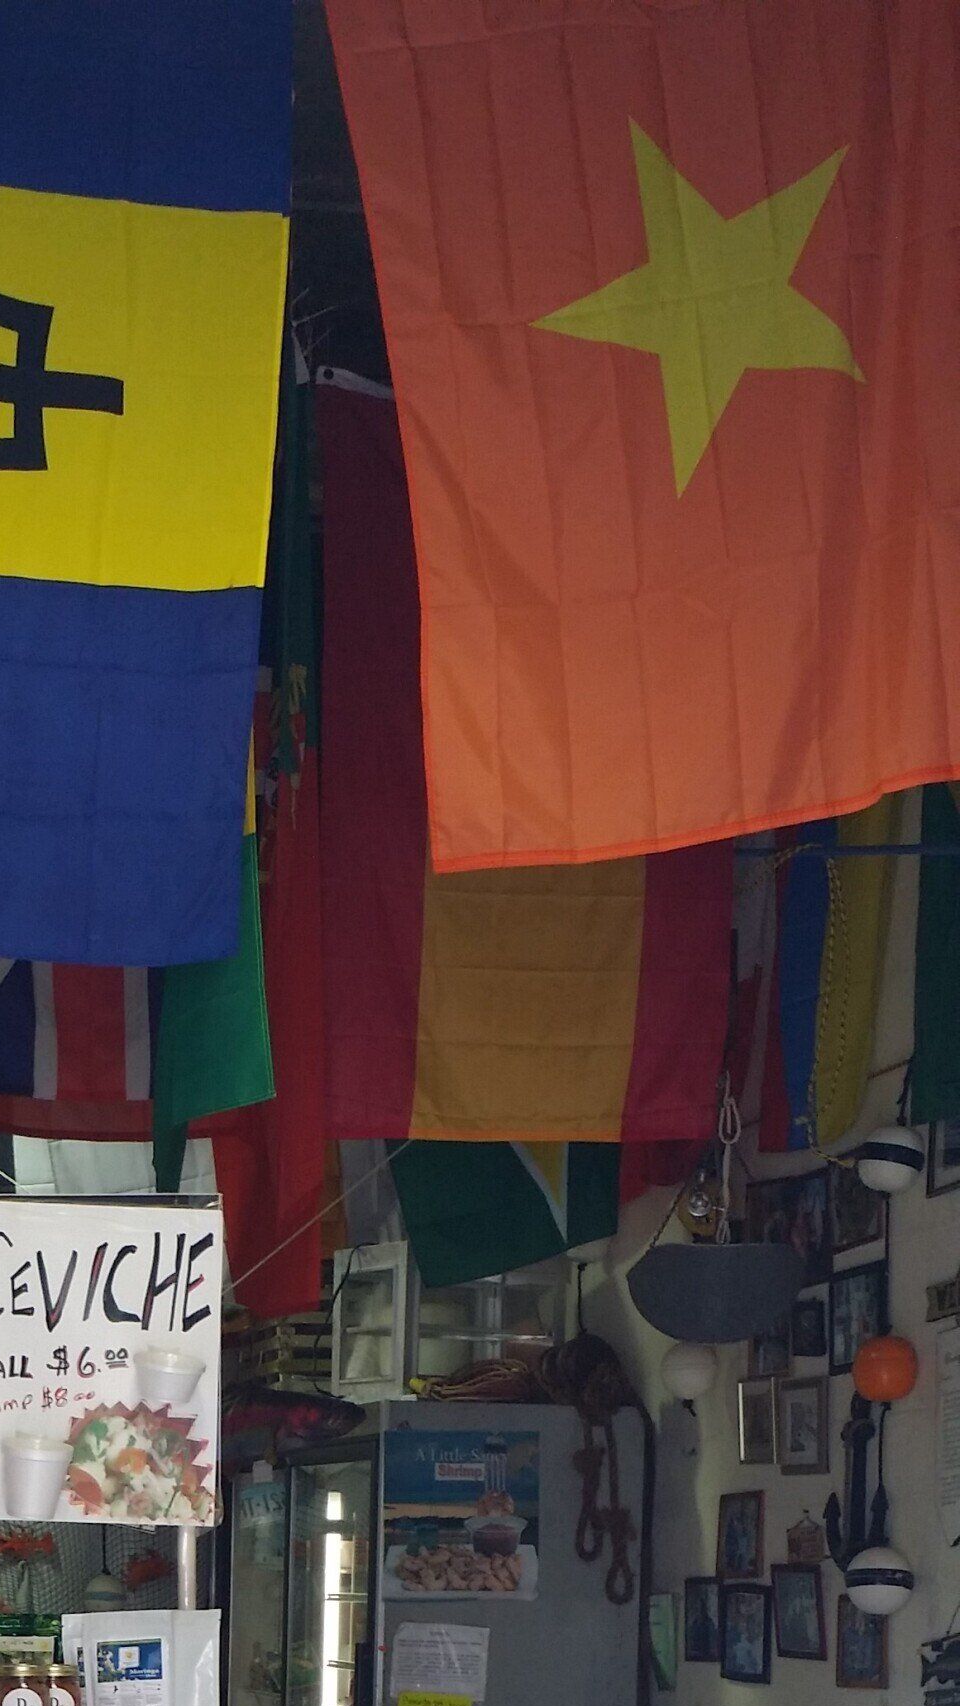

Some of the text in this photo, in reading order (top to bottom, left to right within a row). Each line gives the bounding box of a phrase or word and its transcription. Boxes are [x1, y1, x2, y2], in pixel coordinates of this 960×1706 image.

[414, 1447, 425, 1462] A
[431, 1446, 467, 1462] Little
[437, 1464, 483, 1479] Shrimp
